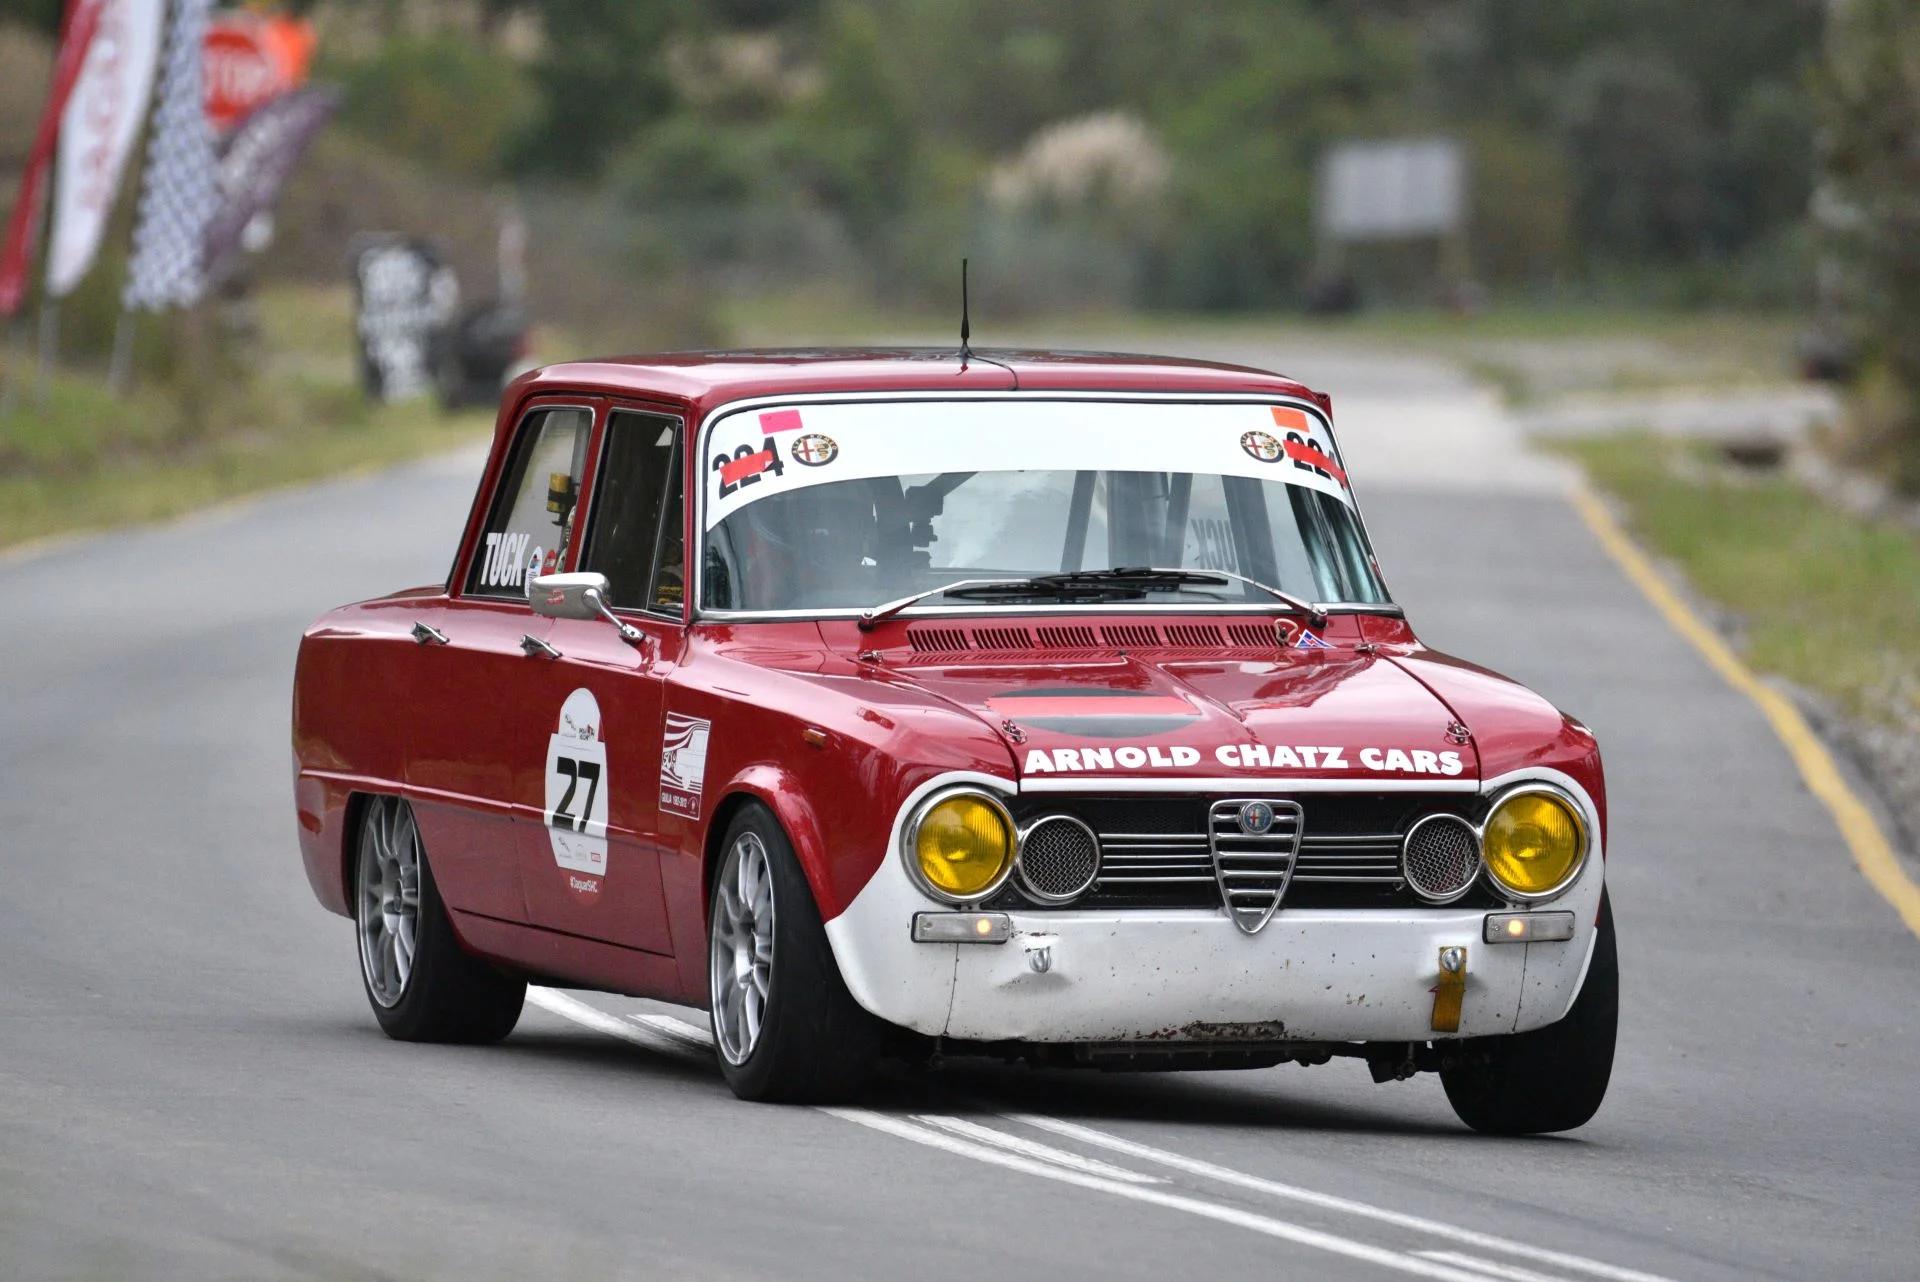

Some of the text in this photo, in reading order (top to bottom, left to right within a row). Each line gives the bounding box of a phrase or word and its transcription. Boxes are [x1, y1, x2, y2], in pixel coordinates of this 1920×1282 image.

[480, 532, 530, 587] TUCK
[1024, 744, 1463, 776] ARNOLD CHATZ CARS
[552, 756, 601, 833] 27
